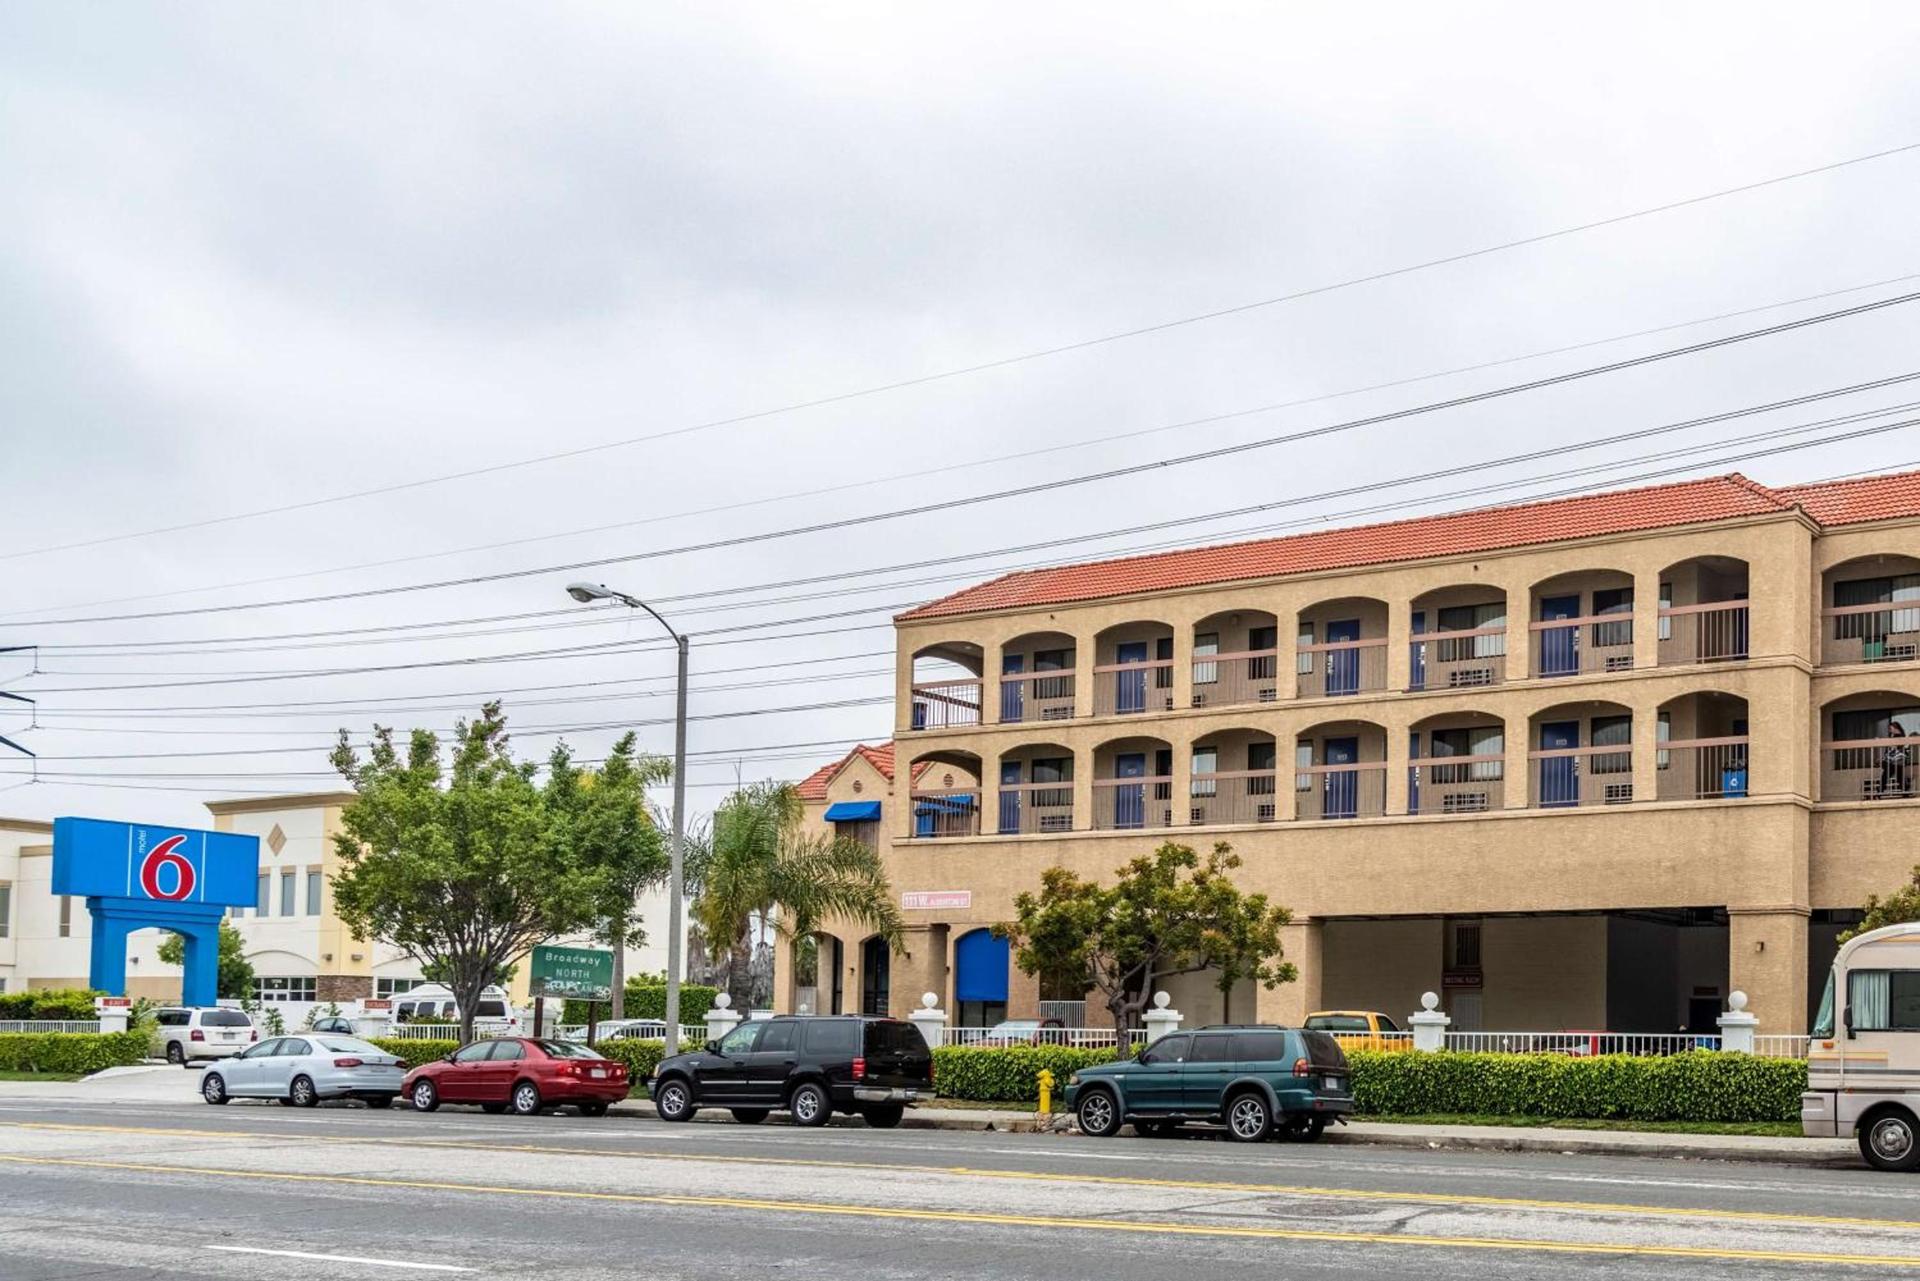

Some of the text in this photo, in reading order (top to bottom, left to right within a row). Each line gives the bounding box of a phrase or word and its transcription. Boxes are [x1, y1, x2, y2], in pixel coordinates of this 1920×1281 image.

[138, 829, 147, 854] motel
[139, 834, 197, 902] 6
[545, 952, 601, 967] Broadway
[555, 968, 590, 979] NORTH
